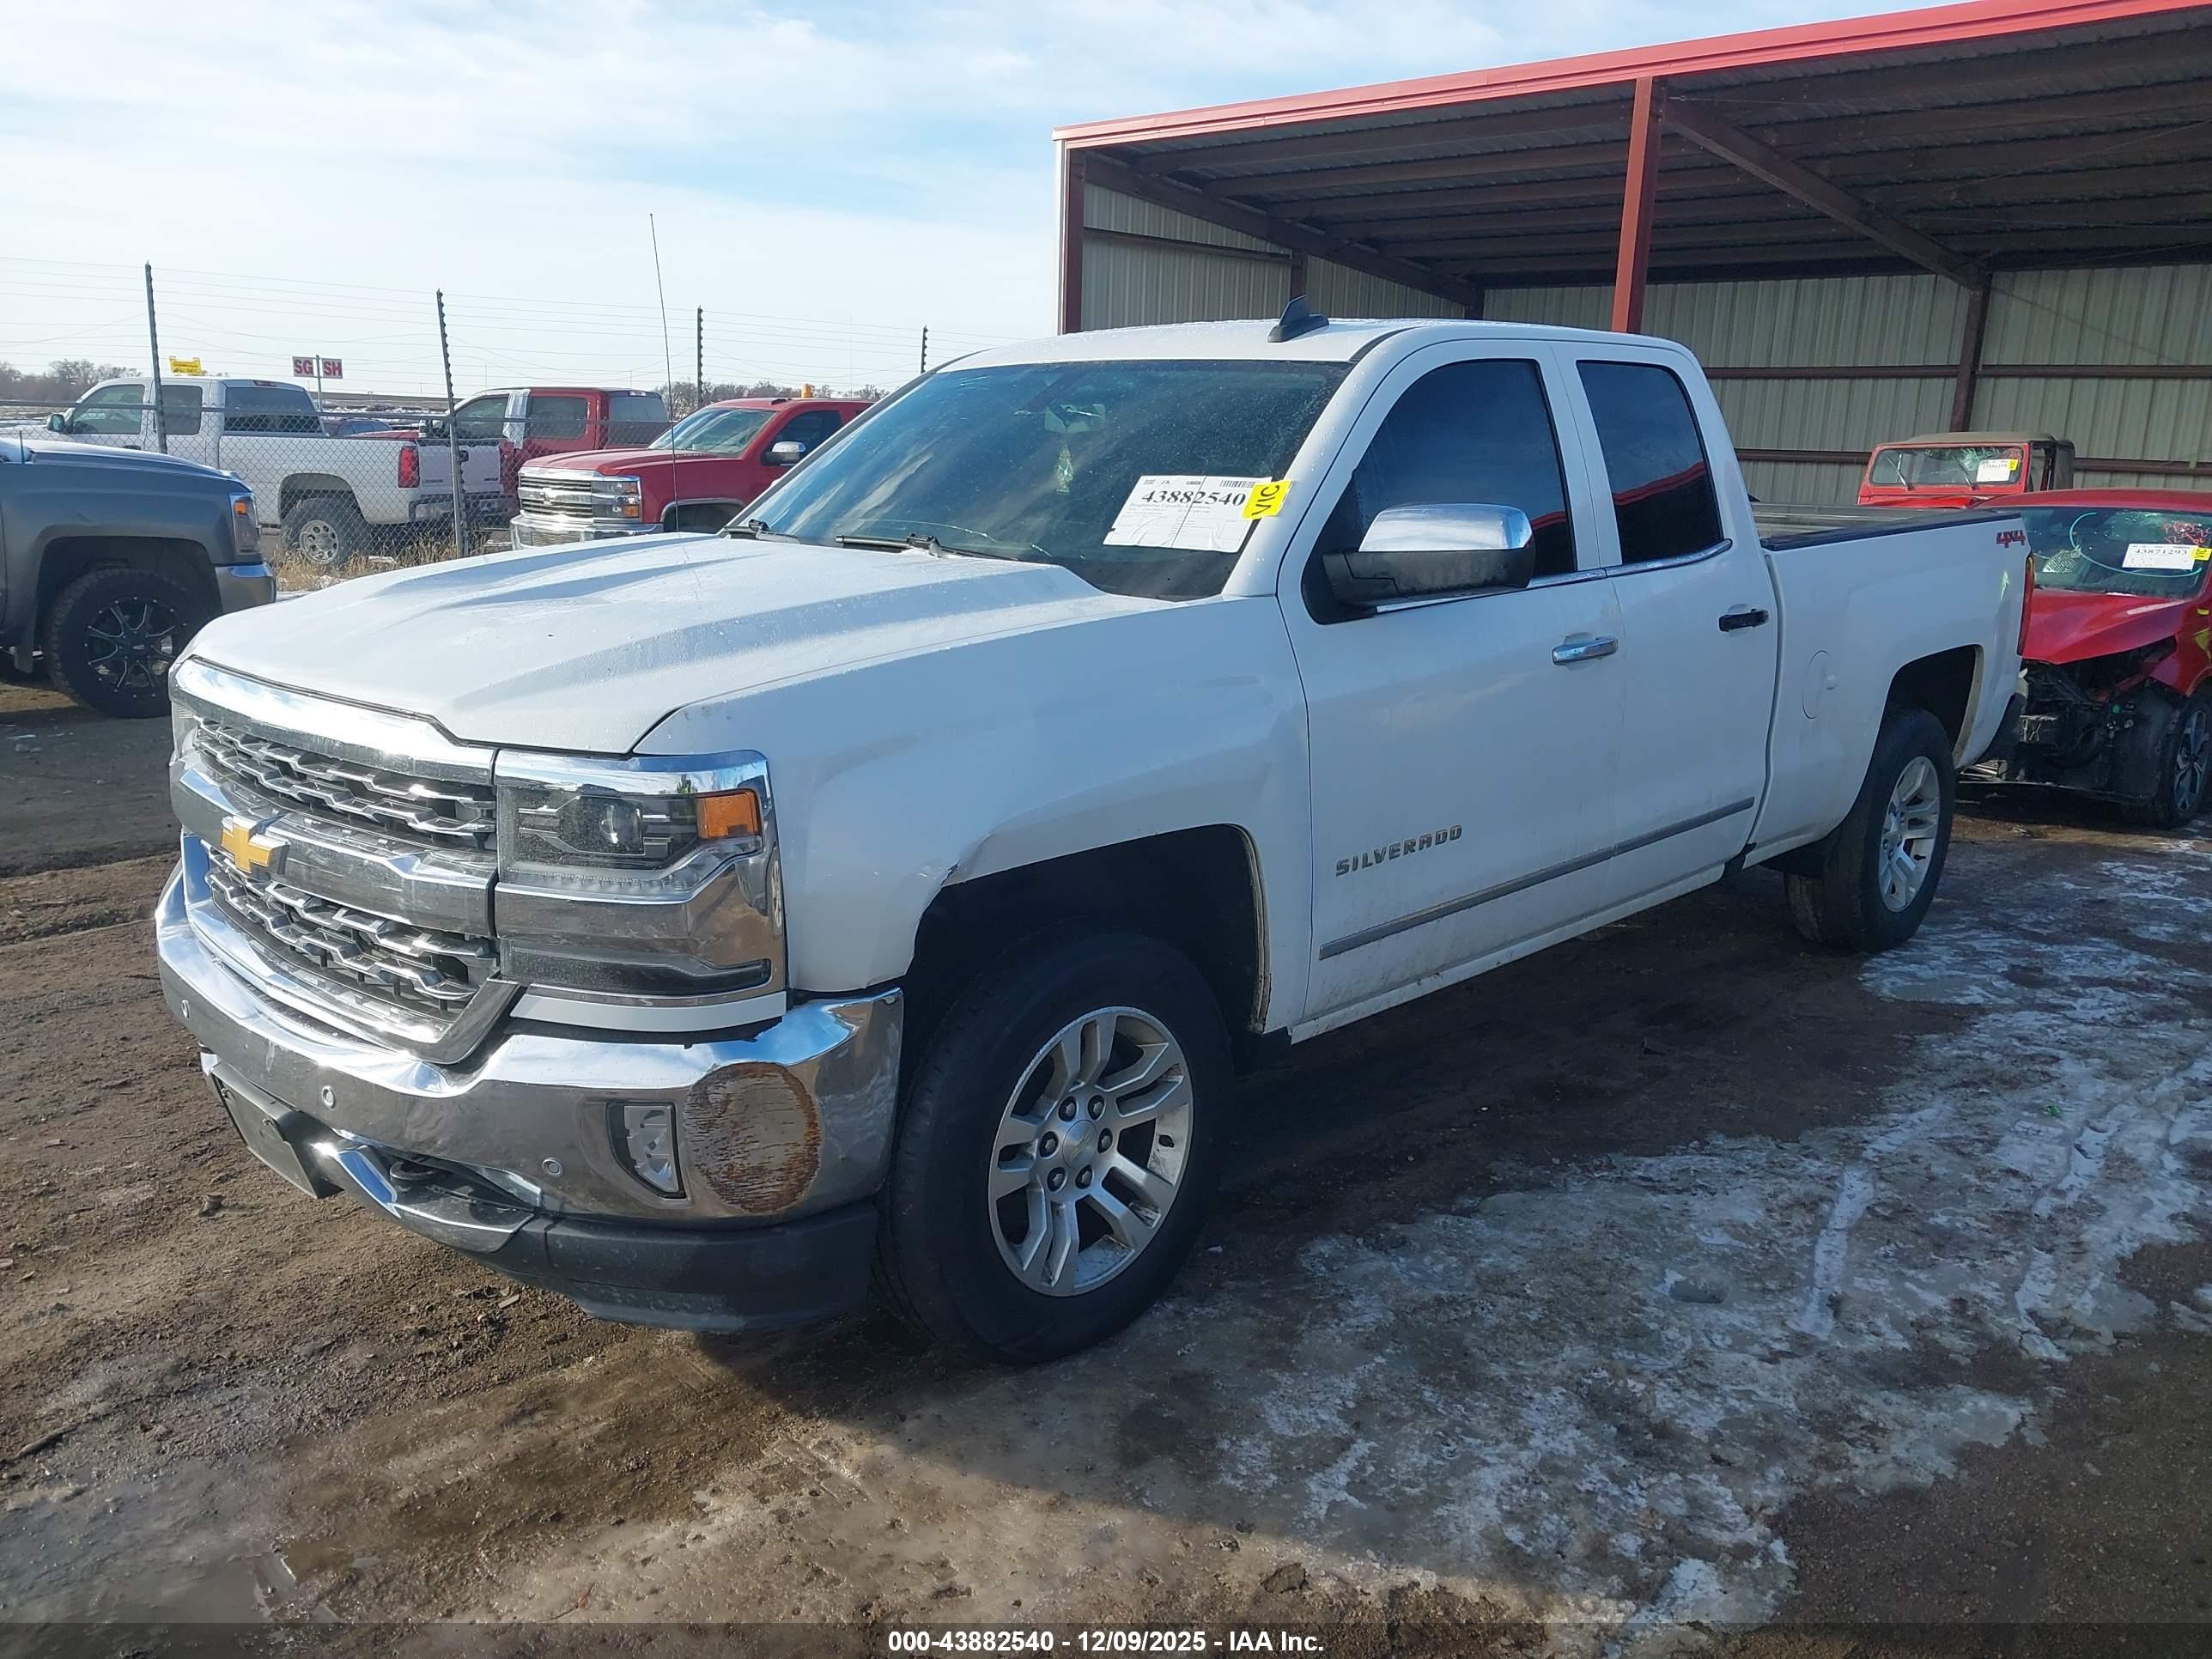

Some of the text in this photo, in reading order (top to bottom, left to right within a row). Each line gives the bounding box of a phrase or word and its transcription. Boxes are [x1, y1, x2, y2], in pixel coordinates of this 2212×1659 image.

[293, 359, 313, 374] SG
[323, 361, 343, 376] SH
[1141, 490, 1247, 506] 43882540
[1250, 484, 1280, 517] VIC
[1335, 824, 1462, 877] SILVERADO
